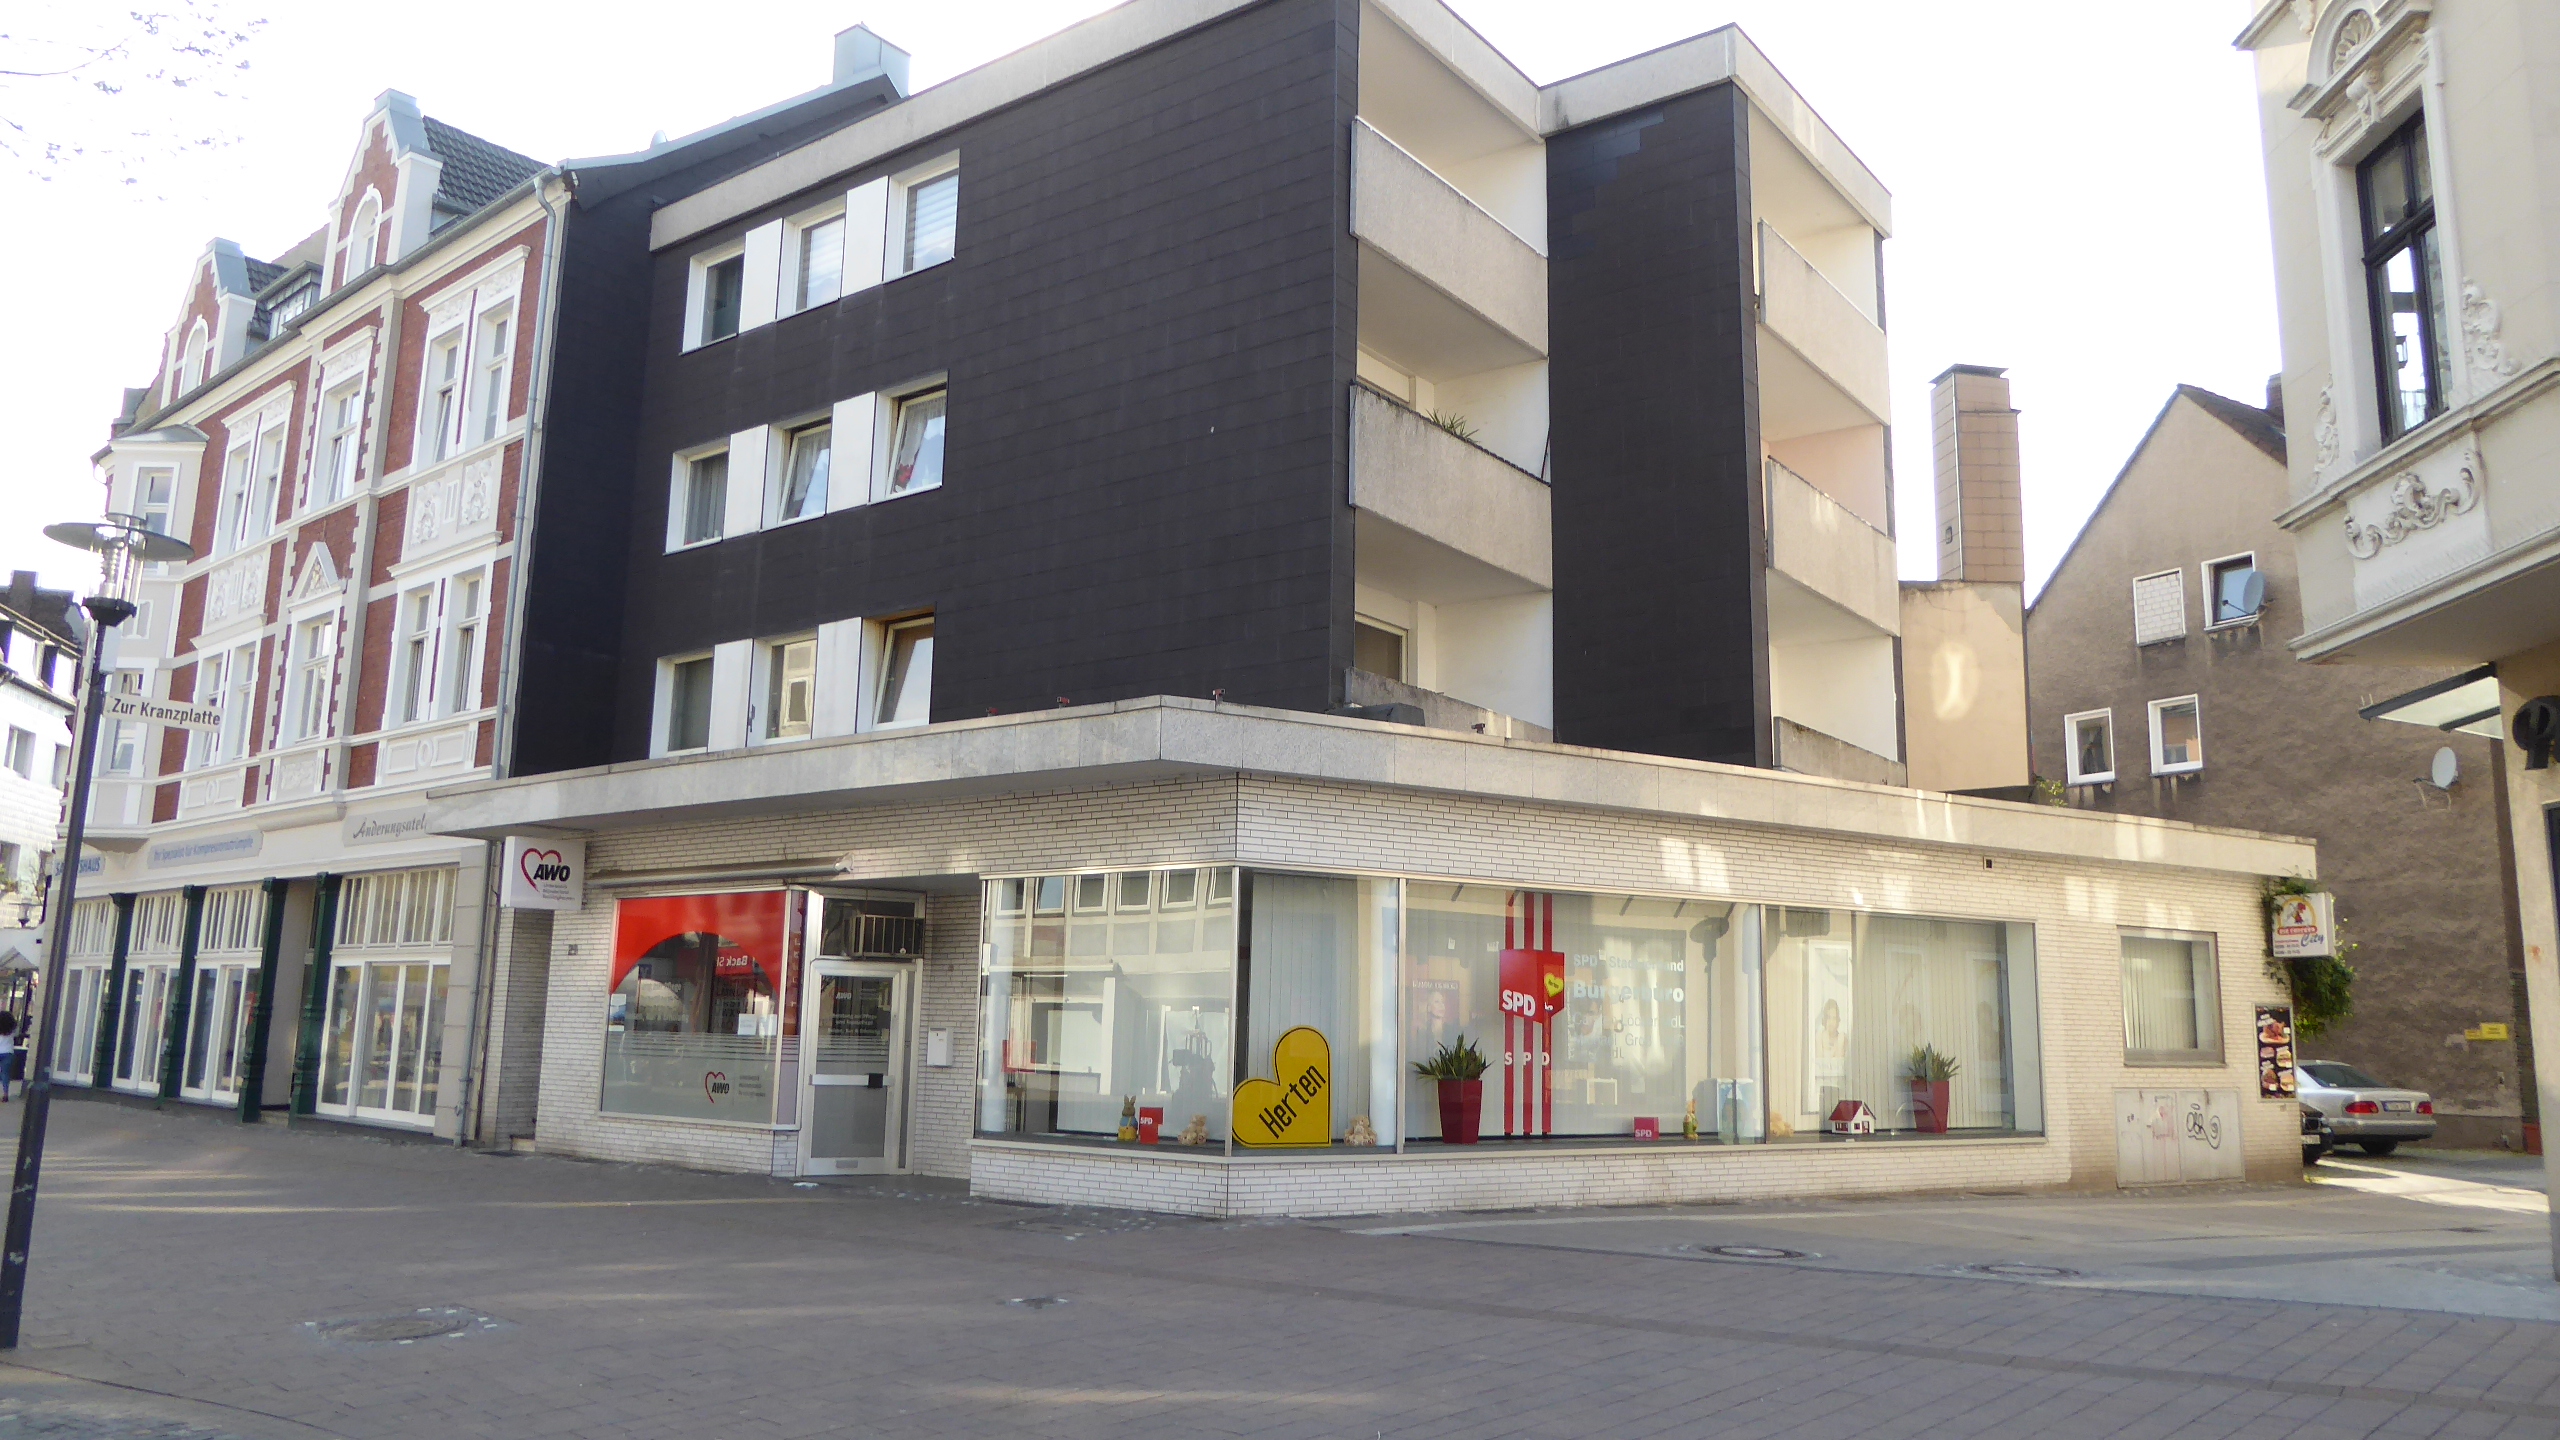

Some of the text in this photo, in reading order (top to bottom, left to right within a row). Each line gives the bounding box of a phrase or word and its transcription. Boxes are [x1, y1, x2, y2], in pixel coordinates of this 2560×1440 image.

[111, 698, 221, 726] Zur Kranzplatte
[533, 863, 571, 882] AWO
[1573, 954, 1598, 968] SPD
[1502, 989, 1536, 1017] SPD
[711, 1082, 730, 1095] AWO
[1258, 1065, 1327, 1140] Herten
[1140, 1116, 1153, 1125] SPD
[1634, 1129, 1652, 1138] SPD
